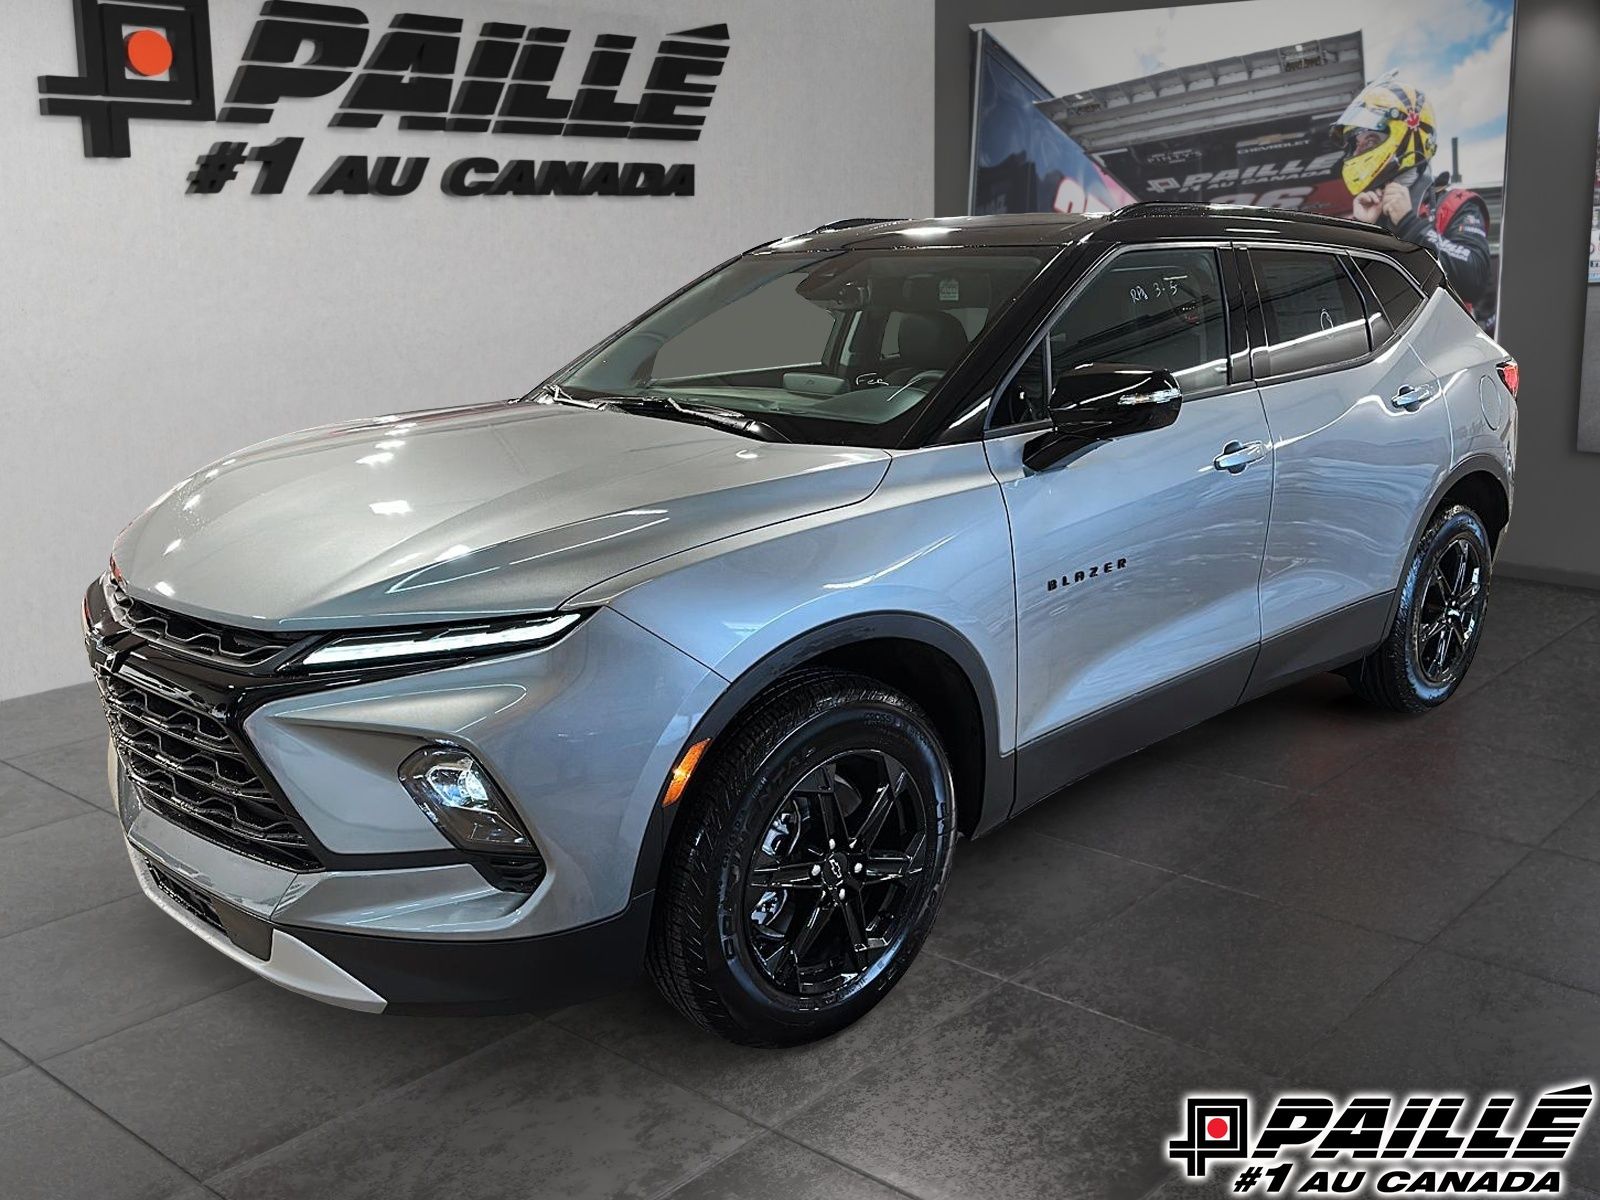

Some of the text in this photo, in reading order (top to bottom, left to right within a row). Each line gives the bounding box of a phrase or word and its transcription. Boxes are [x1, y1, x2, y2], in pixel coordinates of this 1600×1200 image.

[216, 0, 731, 141] PAILLÉ
[1236, 139, 1310, 155] CHEVROLET
[185, 136, 697, 198] #1 AU CANADA
[1240, 169, 1332, 186] CANADA
[1047, 557, 1127, 592] BLAZER
